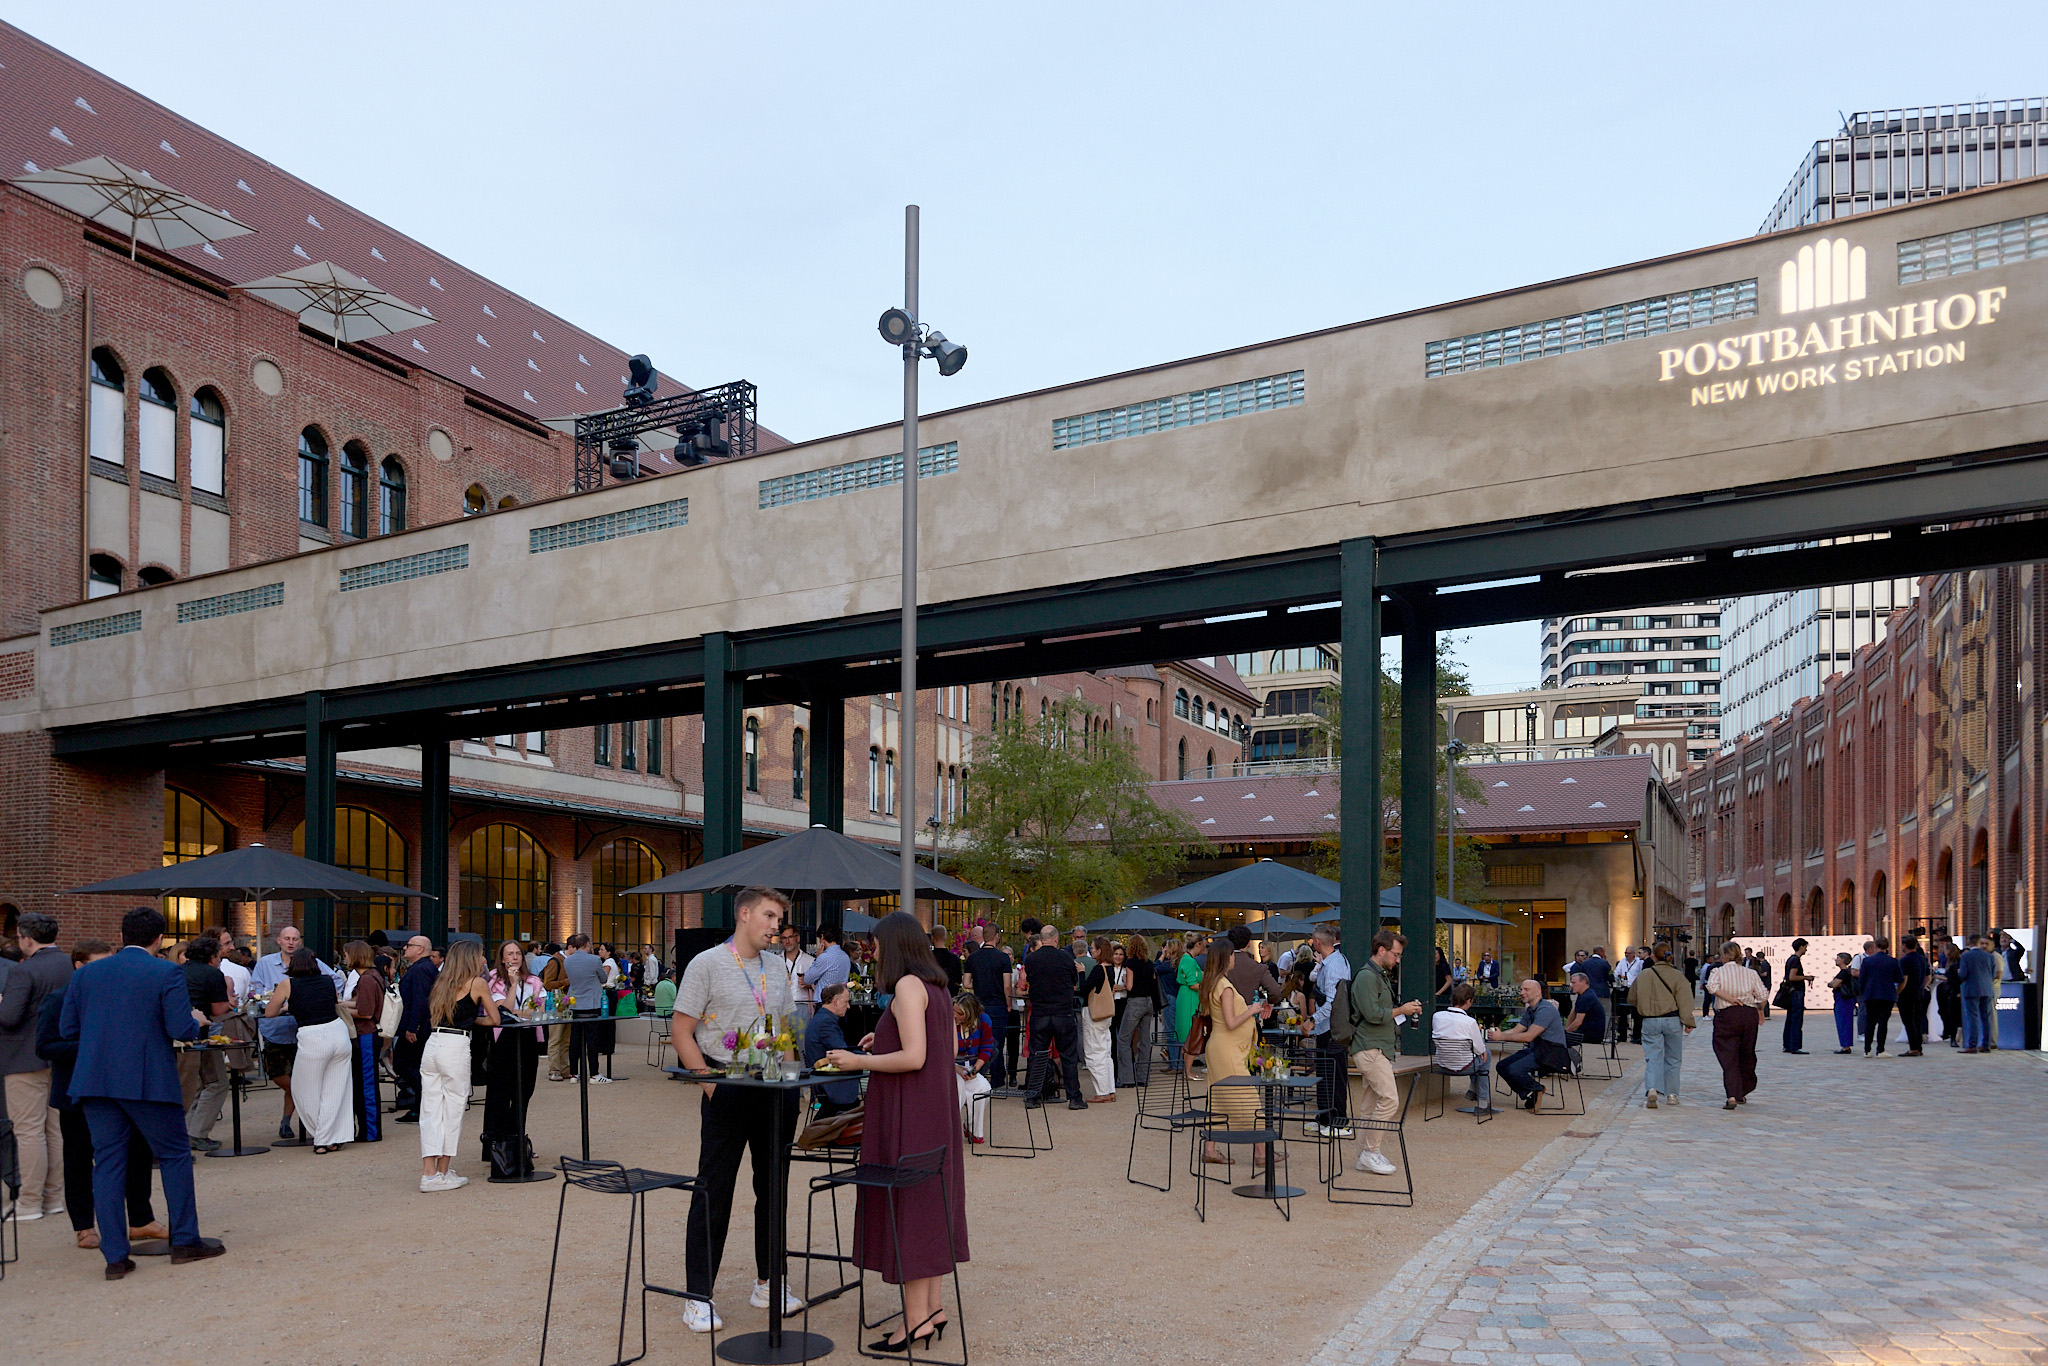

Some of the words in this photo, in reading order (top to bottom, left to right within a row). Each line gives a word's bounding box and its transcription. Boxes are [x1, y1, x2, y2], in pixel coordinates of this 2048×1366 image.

[1658, 286, 2007, 381] POSTBAHNHOF
[1691, 378, 1749, 406] NEW
[1756, 363, 1837, 396] WORK
[1844, 340, 1966, 381] STATION
